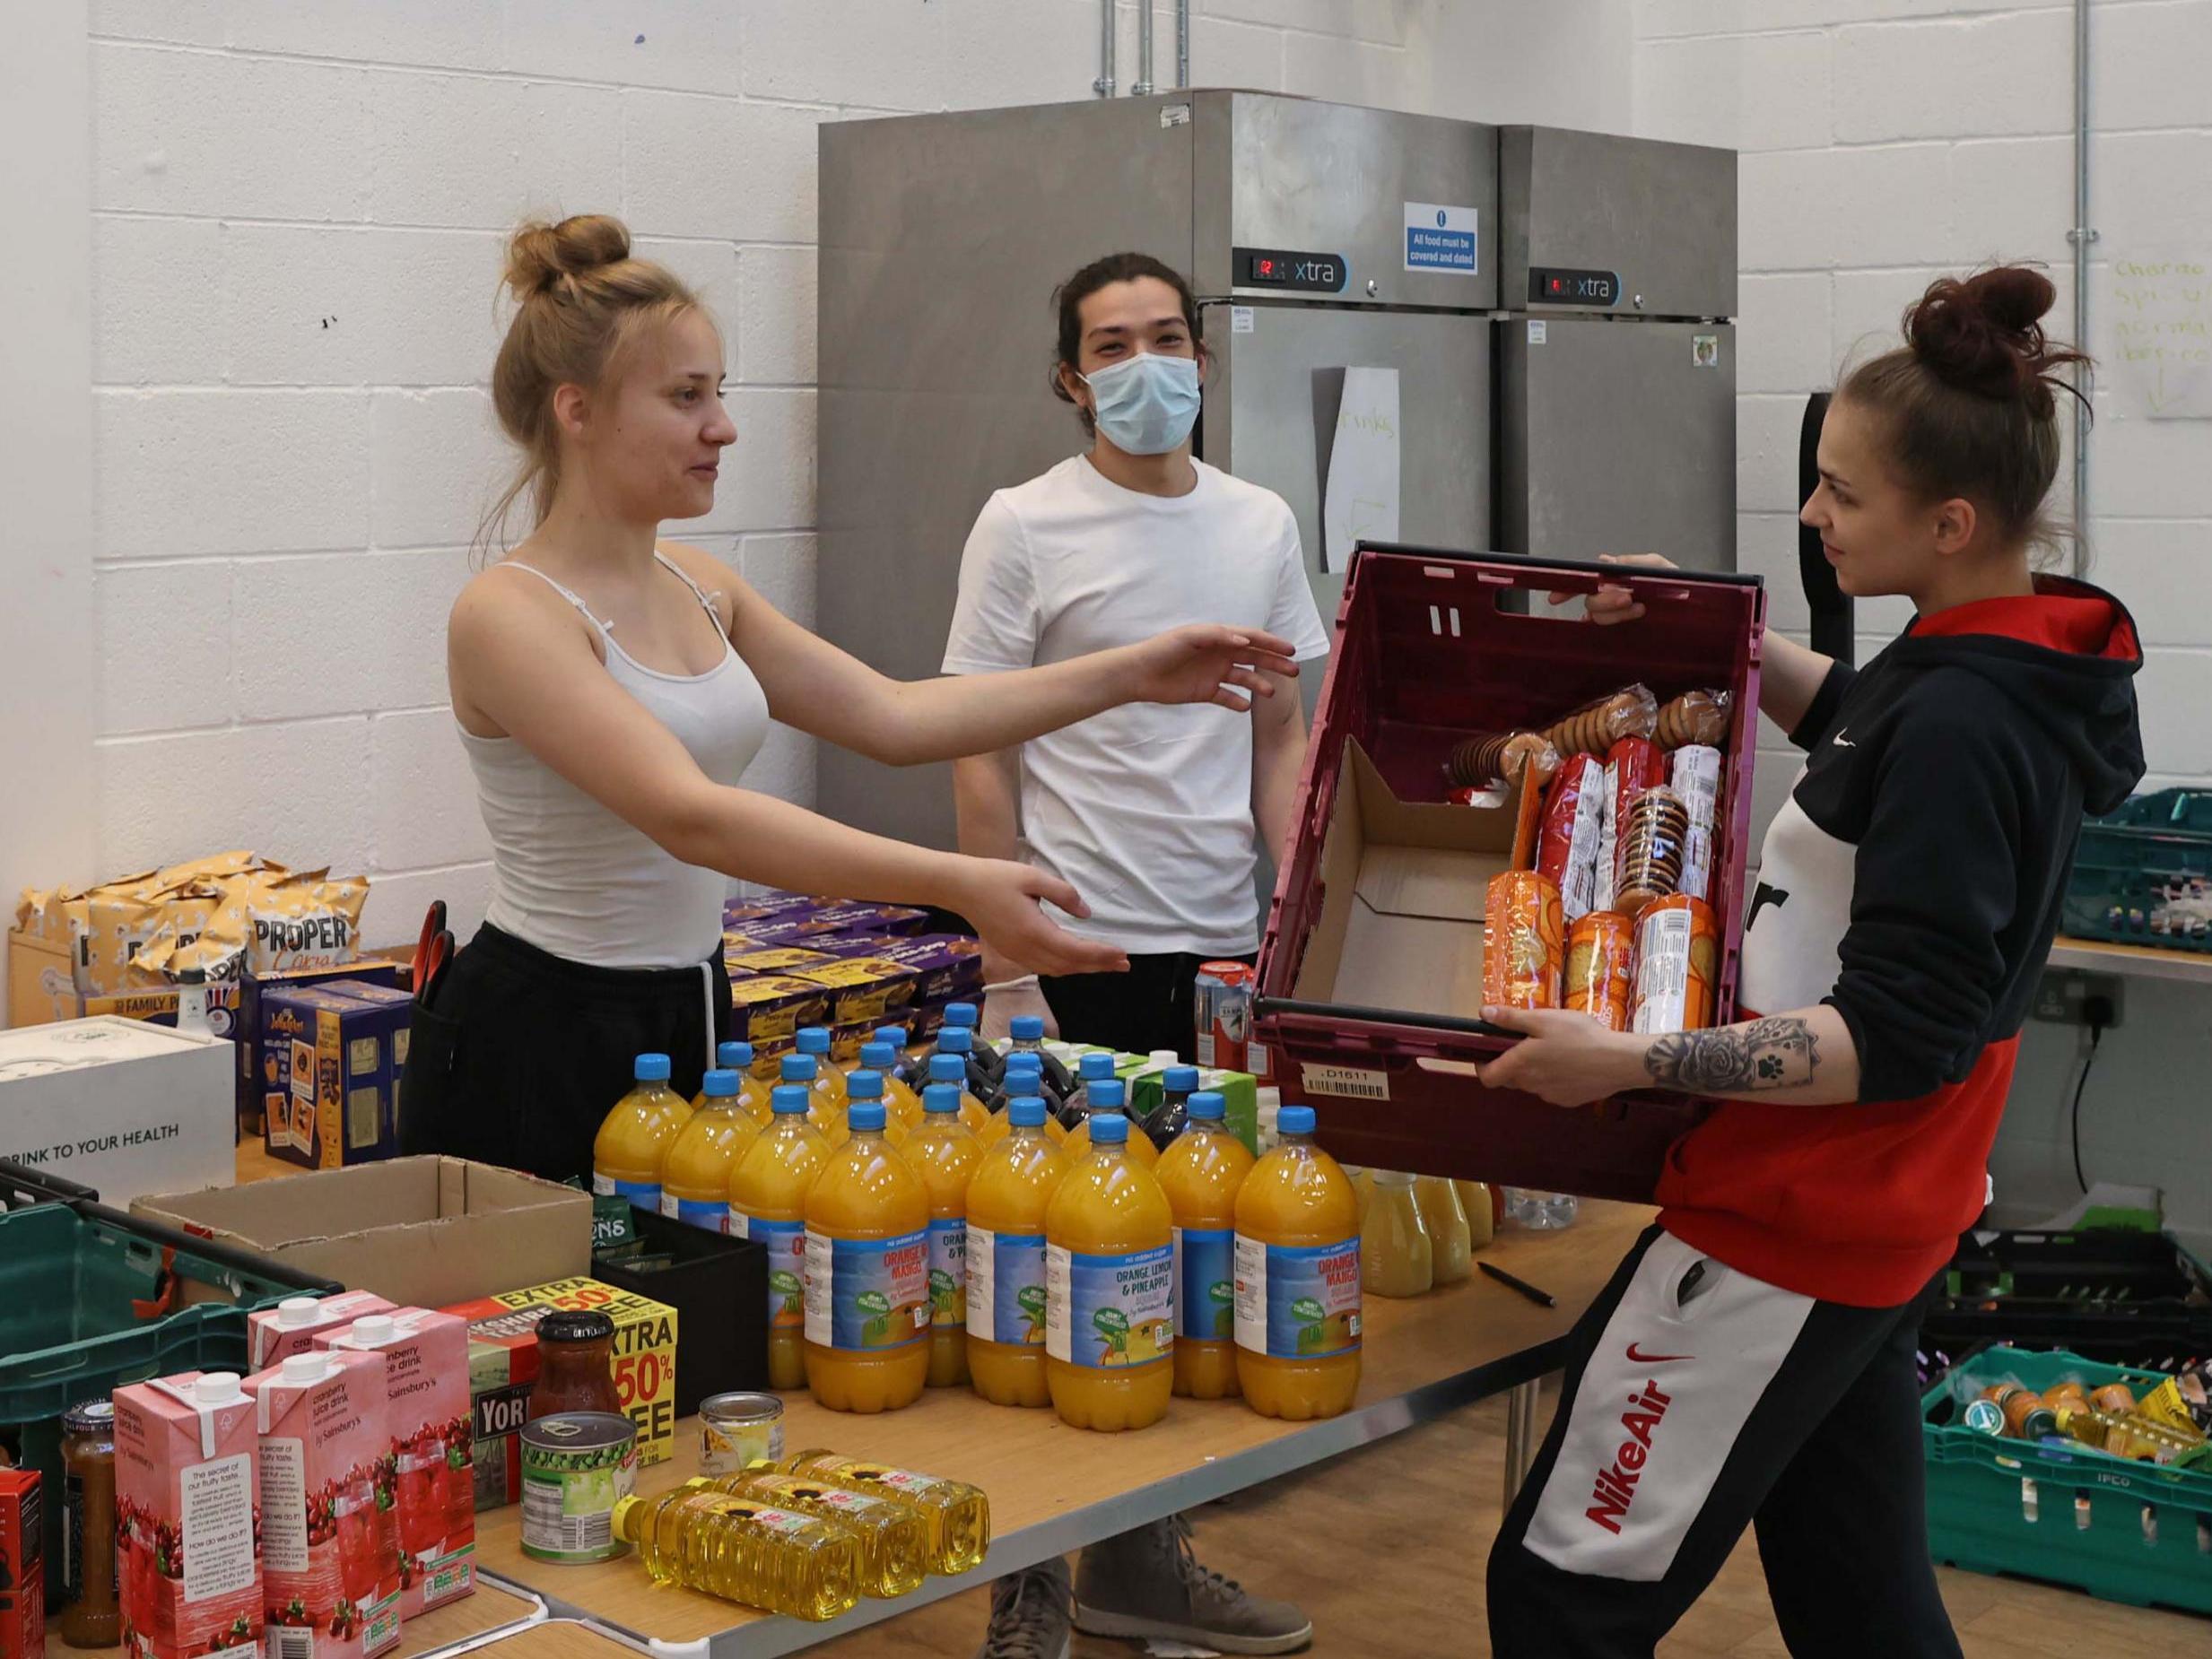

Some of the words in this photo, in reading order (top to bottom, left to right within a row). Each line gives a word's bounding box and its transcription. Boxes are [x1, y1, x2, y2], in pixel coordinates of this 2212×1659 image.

[1425, 234, 1441, 247] food
[1441, 238, 1459, 248] must
[1460, 238, 1469, 248] be
[1410, 251, 1439, 262] covered
[1440, 253, 1452, 263] and
[1454, 254, 1473, 265] dated
[1295, 260, 1334, 282] xtra
[1578, 277, 1609, 297] xtra
[254, 916, 347, 951] PROPER
[126, 996, 167, 1012] FAMILY
[53, 1144, 73, 1160] TO
[78, 1135, 118, 1155] YOUR
[123, 1123, 179, 1146] HEALTH
[884, 1245, 920, 1267] ORANGE
[1318, 1254, 1355, 1274] ORANGE
[892, 1261, 922, 1281] MANGO
[1327, 1269, 1357, 1286] MANGO
[500, 1280, 595, 1307] EXTRA
[1122, 1284, 1130, 1296] &
[1131, 1274, 1169, 1295] PINEAPPLE
[594, 1295, 652, 1315] EE
[469, 1307, 553, 1333] KSHIRE
[612, 1316, 673, 1356] XTRA
[387, 1346, 419, 1361] nberry
[398, 1355, 422, 1370] drink
[388, 1377, 437, 1401] Sainsbury's
[615, 1351, 673, 1407] 50%
[330, 1393, 349, 1408] drink
[323, 1416, 361, 1441] Sainsbury's
[630, 1401, 672, 1444] EE
[1585, 1378, 1671, 1535] NikeAir
[208, 1464, 230, 1476] secret
[231, 1462, 239, 1471] of
[188, 1482, 200, 1490] our
[189, 1542, 205, 1550] How
[228, 1531, 239, 1540] do
